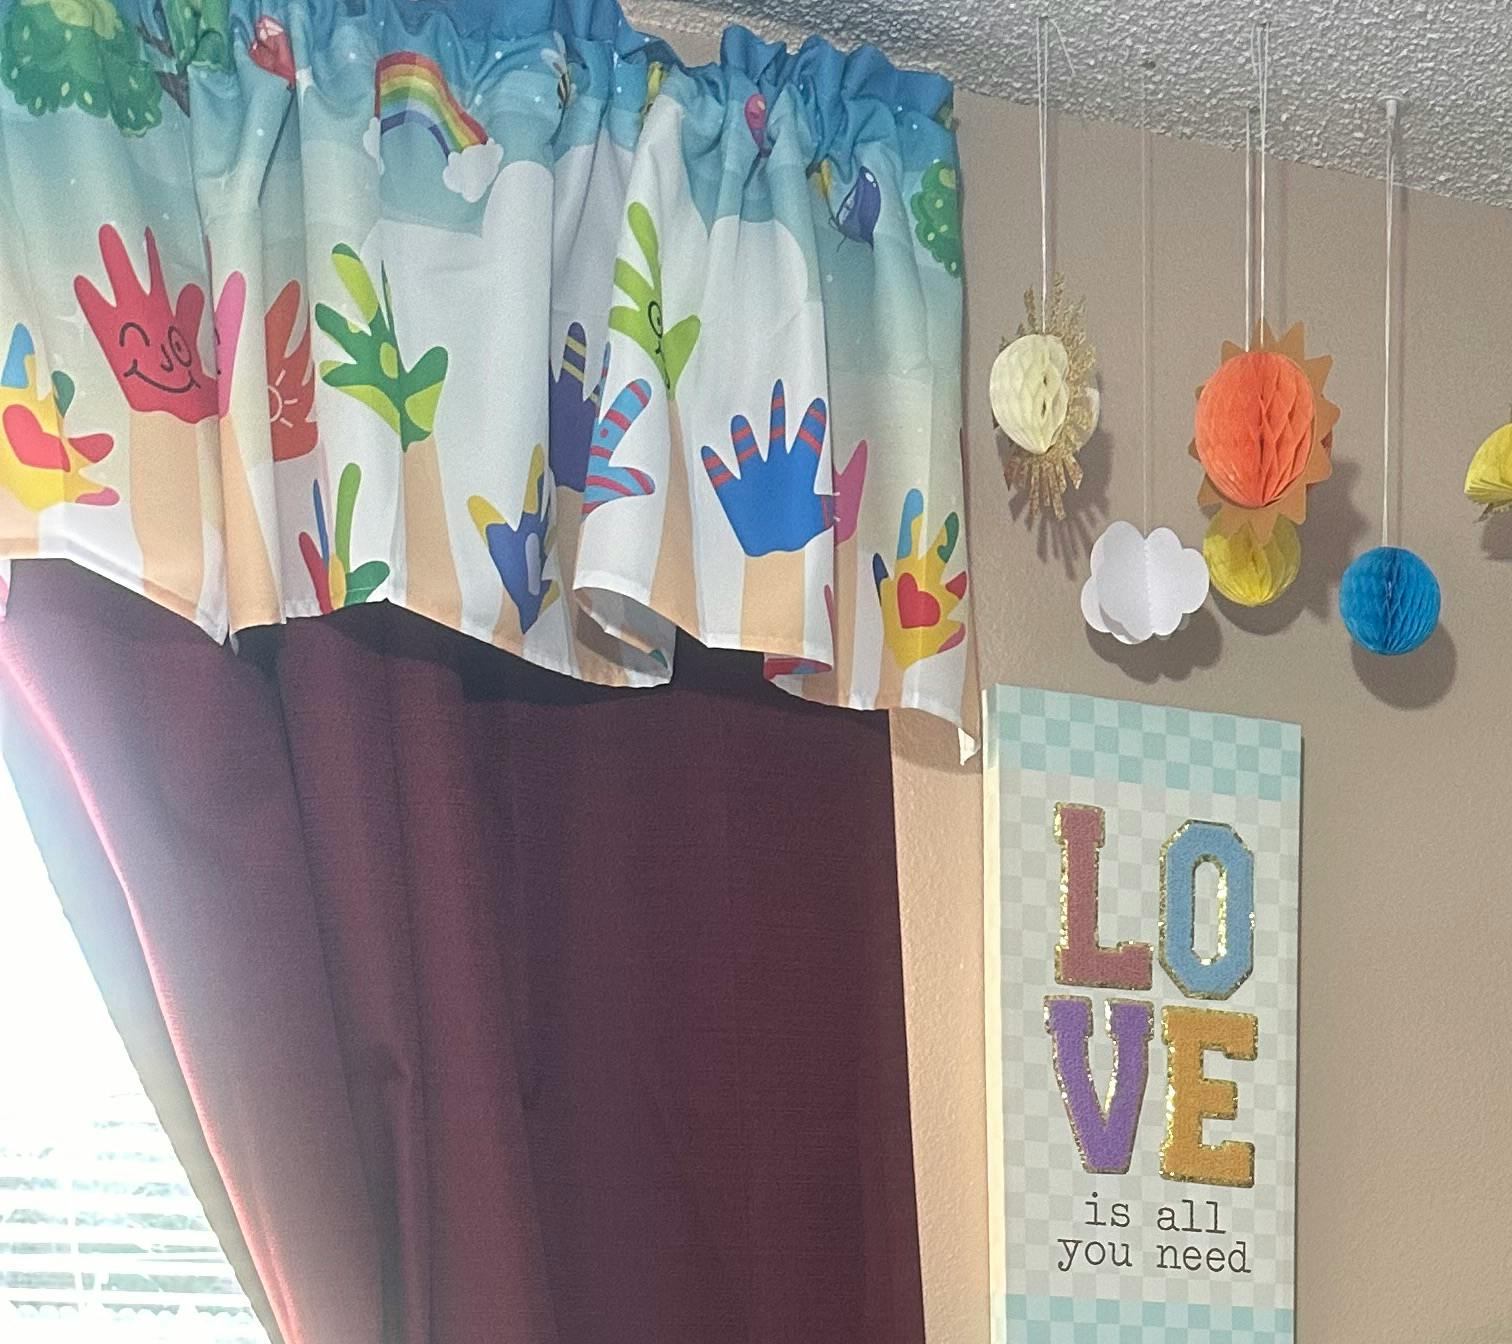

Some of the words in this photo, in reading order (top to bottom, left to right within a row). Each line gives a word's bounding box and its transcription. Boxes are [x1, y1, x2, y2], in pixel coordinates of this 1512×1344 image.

[1085, 1191, 1130, 1228] is
[1156, 1199, 1227, 1234] all
[1057, 1238, 1133, 1272] you
[1156, 1241, 1252, 1274] need
